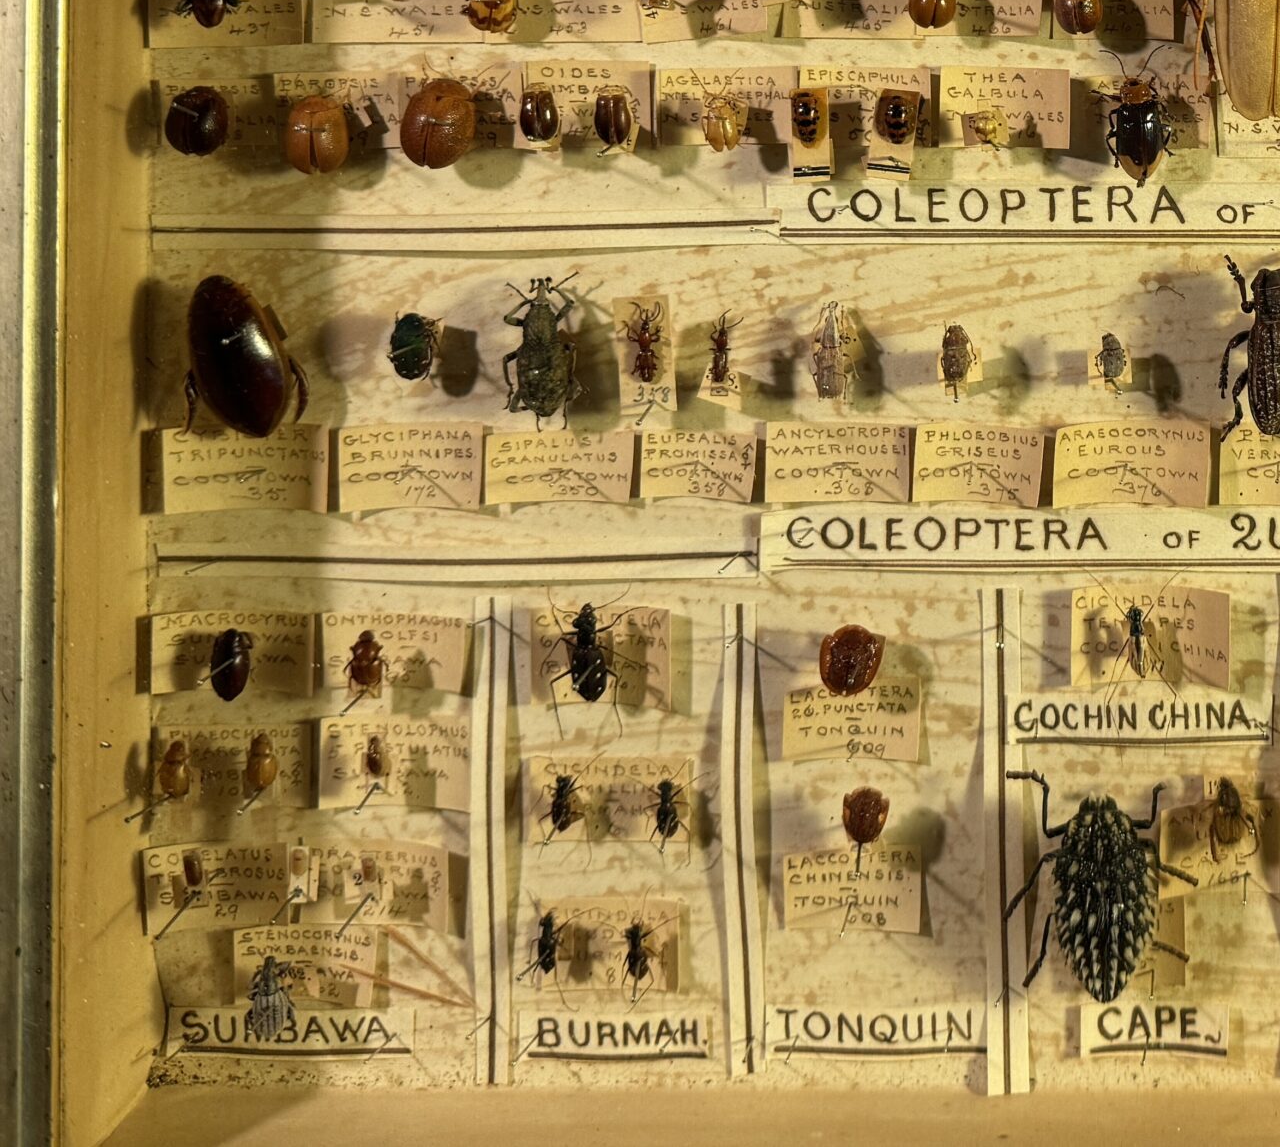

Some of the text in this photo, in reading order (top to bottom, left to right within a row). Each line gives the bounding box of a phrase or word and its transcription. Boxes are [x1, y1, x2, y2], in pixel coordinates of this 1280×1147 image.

[664, 75, 775, 86] AGELASTICA
[807, 70, 920, 83] EPISCAPHULA
[965, 72, 1025, 83] THEA
[280, 79, 379, 90] PAROPSIS
[948, 87, 1044, 100] GALBULA
[808, 185, 1186, 224] COLEOPTERA
[1216, 205, 1257, 224] OF
[344, 429, 472, 445] GLYCIPHANA
[648, 433, 737, 445] EUPSALIS
[771, 427, 907, 440] ANCYLOTROPIS
[925, 431, 1039, 446] PHLOEOBIUS
[500, 437, 592, 451] SIPALUS
[767, 443, 906, 456] WATERHOUSEI
[1078, 444, 1166, 456] EUROUS
[170, 449, 325, 463] TRIPUNCTATUS
[490, 452, 618, 466] GRANULATUS
[936, 445, 1022, 459] GRISEUS
[173, 471, 312, 486] COOKTOWN
[348, 468, 472, 483] COOKTOWN
[506, 470, 628, 484] COOKTOWN
[648, 466, 743, 481] COOKTOWN
[775, 467, 900, 479] COOKTOWN
[919, 468, 1031, 485] COOKTOWN
[1068, 468, 1199, 481] COOKTOWN
[786, 517, 1106, 550] COLEOPTERA
[1164, 531, 1201, 548] OF
[159, 615, 310, 629] MACROGYRUS
[1014, 701, 1138, 731] COCHIN
[800, 725, 904, 736] TONQUIN
[795, 895, 899, 908] TONQUIN
[778, 1009, 973, 1041] TONQUIN
